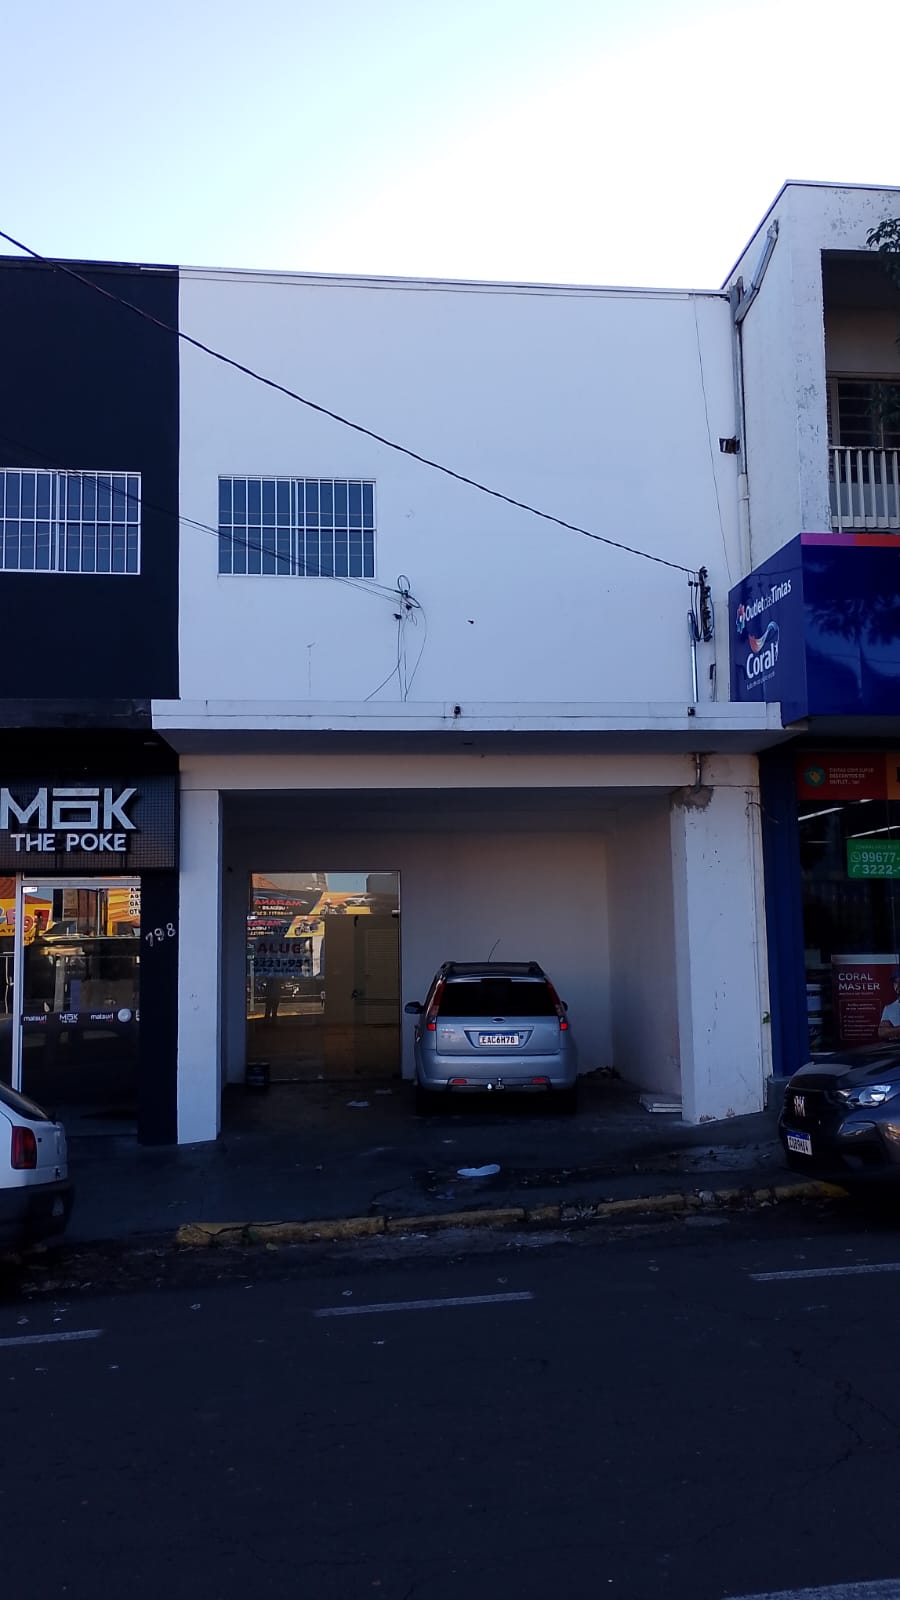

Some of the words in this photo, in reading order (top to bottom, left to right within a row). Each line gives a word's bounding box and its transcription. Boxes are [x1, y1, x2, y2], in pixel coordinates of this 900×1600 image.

[746, 642, 776, 679] Coral
[10, 833, 56, 852] THE
[66, 833, 127, 852] POKE
[862, 864, 900, 875] 3222-
[838, 972, 873, 981] CORAL
[838, 983, 881, 991] MASTER
